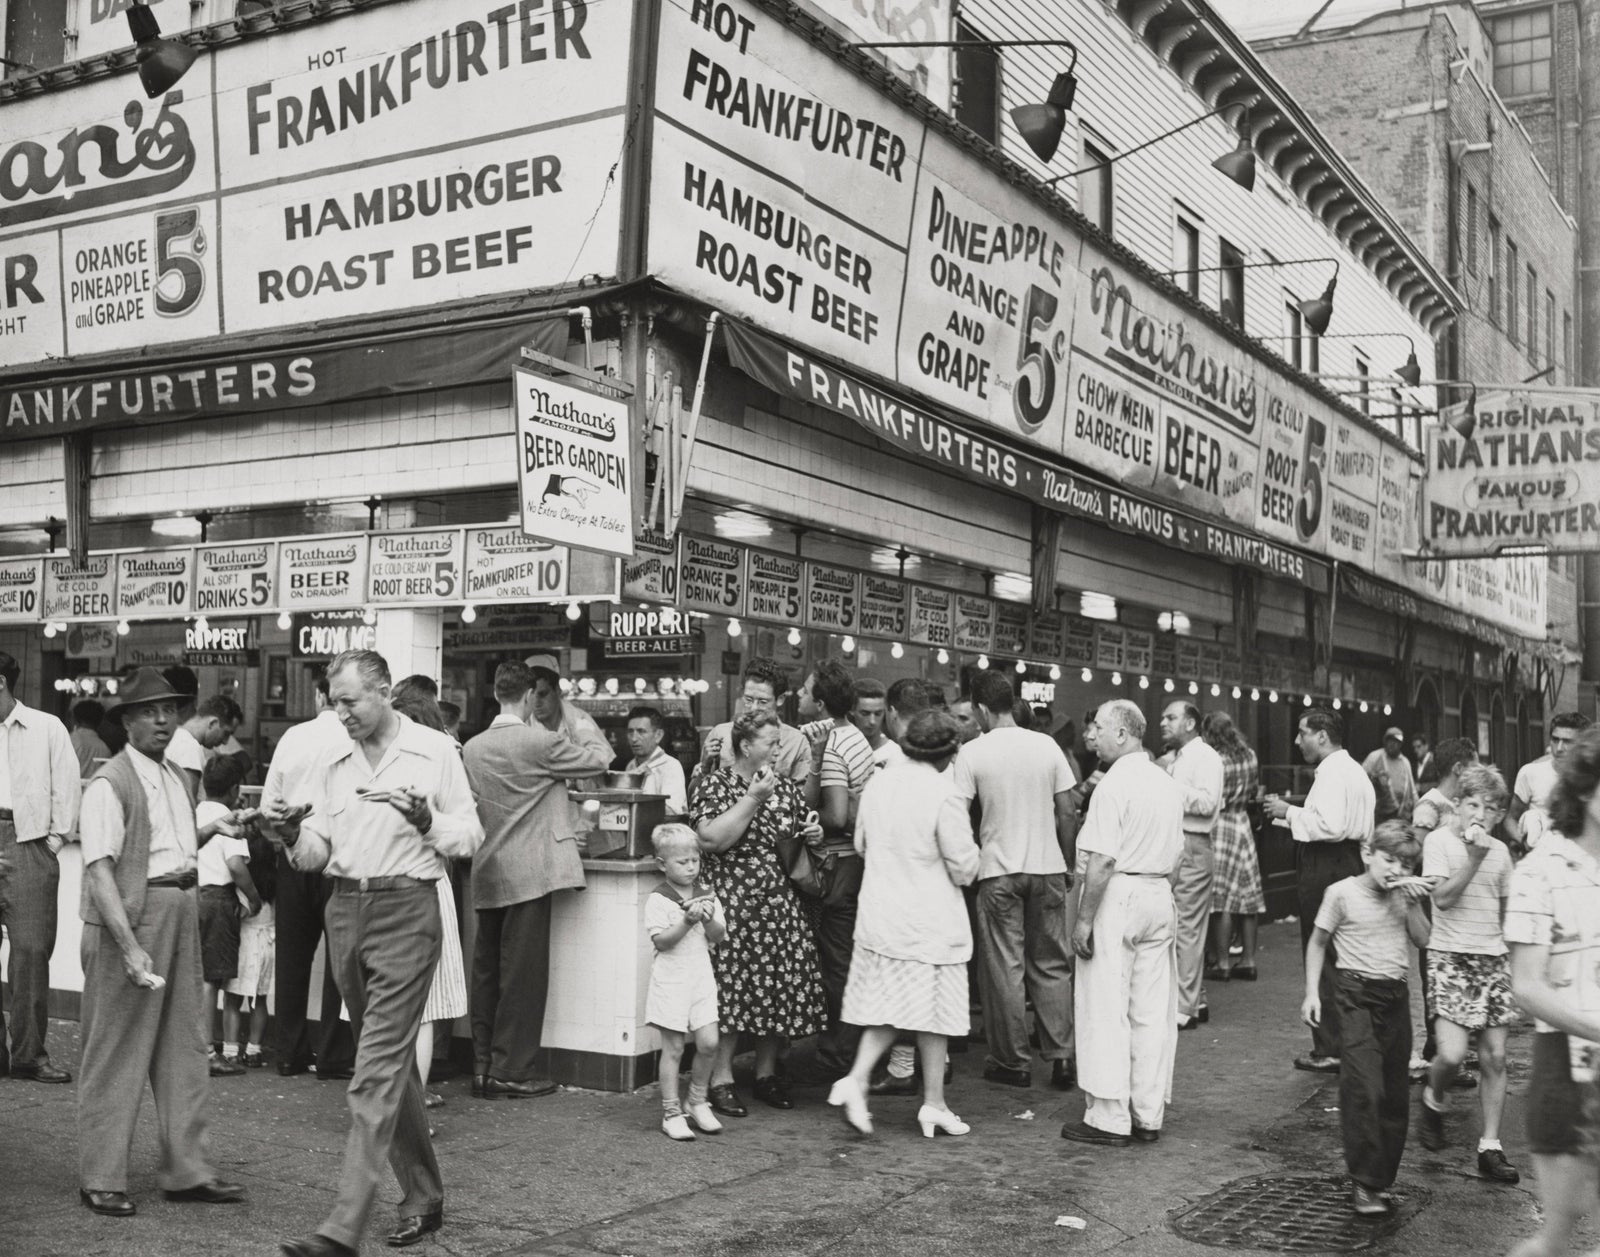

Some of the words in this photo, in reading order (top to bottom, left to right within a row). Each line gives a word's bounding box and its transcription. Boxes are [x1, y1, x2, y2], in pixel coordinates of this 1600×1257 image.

[690, 0, 756, 55] HOT
[309, 47, 346, 70] HOT
[247, 0, 592, 156] FRANKFURTER
[682, 47, 907, 184] FRANKFURTER
[284, 154, 563, 242] HAMBURGER
[683, 161, 873, 296] HAMBURGER
[927, 185, 1065, 289] PINEAPPLE
[75, 239, 148, 275] ORANGE
[258, 250, 395, 304] ROAST
[412, 226, 533, 281] BEEF
[71, 269, 150, 304] PINEAPPLE
[695, 229, 804, 314] ROAST
[810, 283, 879, 345] BEEF
[930, 253, 1020, 329] ORANGE
[75, 306, 94, 330] and
[95, 297, 145, 326] GRAPE
[945, 309, 986, 346] AND
[1090, 266, 1257, 420] Nathan's
[917, 331, 992, 401] GRAPE
[6, 356, 317, 427] ANKFURTERS
[1153, 373, 1201, 406] FAMOUS
[529, 387, 616, 433] Nathan's
[1077, 372, 1119, 417] CHOW
[1119, 393, 1155, 435] MEIN
[1267, 394, 1283, 425] ICE
[1283, 404, 1304, 435] COLD
[538, 417, 580, 435] FAMOUS
[786, 351, 1018, 488] FRANKFURTERS
[1479, 404, 1585, 431] RIGINAL
[1074, 408, 1153, 467] BARBECUE
[1437, 428, 1600, 471] NATHANS
[523, 431, 565, 474] BEER
[568, 443, 627, 496] GARDEN
[1163, 415, 1222, 496] BEER
[1264, 447, 1299, 489] ROOT
[1477, 478, 1567, 499] FAMOUS
[526, 499, 537, 514] No
[537, 501, 558, 519] Extra
[560, 507, 588, 529] Charge
[590, 514, 599, 528] At
[599, 515, 626, 534] Tables
[1109, 494, 1174, 540] FAMOUS
[1261, 483, 1294, 528] BEER
[203, 546, 268, 566] Nathan's
[284, 544, 357, 562] Nathan's
[378, 533, 454, 553] Nathan's
[687, 539, 740, 564] Nathan's
[1206, 526, 1305, 581] FRANKFURTERS
[122, 555, 187, 574] Nathan's
[372, 562, 383, 576] ICE
[384, 561, 402, 576] COLD
[402, 560, 433, 575] CREAMY
[477, 557, 495, 568] HOT
[623, 558, 662, 583] FRANKFURTER
[681, 564, 723, 588] ORANGE
[752, 553, 801, 577] Nathan's
[56, 583, 69, 593] ICE
[71, 580, 99, 593] COLD
[120, 583, 136, 592] HOT
[203, 575, 216, 588] ALL
[217, 573, 239, 586] SOFT
[251, 572, 273, 607] 5¢
[290, 570, 350, 590] BEER
[373, 578, 403, 596] ROOT
[405, 577, 433, 595] BEER
[434, 561, 459, 597] 5¢
[467, 561, 534, 593] FRANKFURTER
[749, 579, 786, 599] PINEAPPLE
[811, 566, 855, 588] Nathan's
[865, 577, 905, 600] Nathan's
[72, 592, 110, 616] BEER
[120, 581, 167, 608] FRANKFURTER
[198, 587, 248, 610] DRINKS
[290, 589, 304, 599] ON
[306, 587, 349, 599] DRAUGHT
[496, 587, 508, 597] ON
[510, 586, 531, 596] ROLL
[685, 583, 721, 605] DRINK
[809, 590, 840, 608] GRAPE
[752, 596, 782, 616] DRINK
[811, 606, 839, 625] DRINK
[915, 608, 929, 621] ICE
[929, 610, 949, 624] COLD
[878, 614, 895, 633] BEER
[927, 623, 950, 644] BEER
[185, 628, 247, 650] RUPPERT
[299, 625, 348, 655] CHOW
[616, 814, 627, 825] 10
